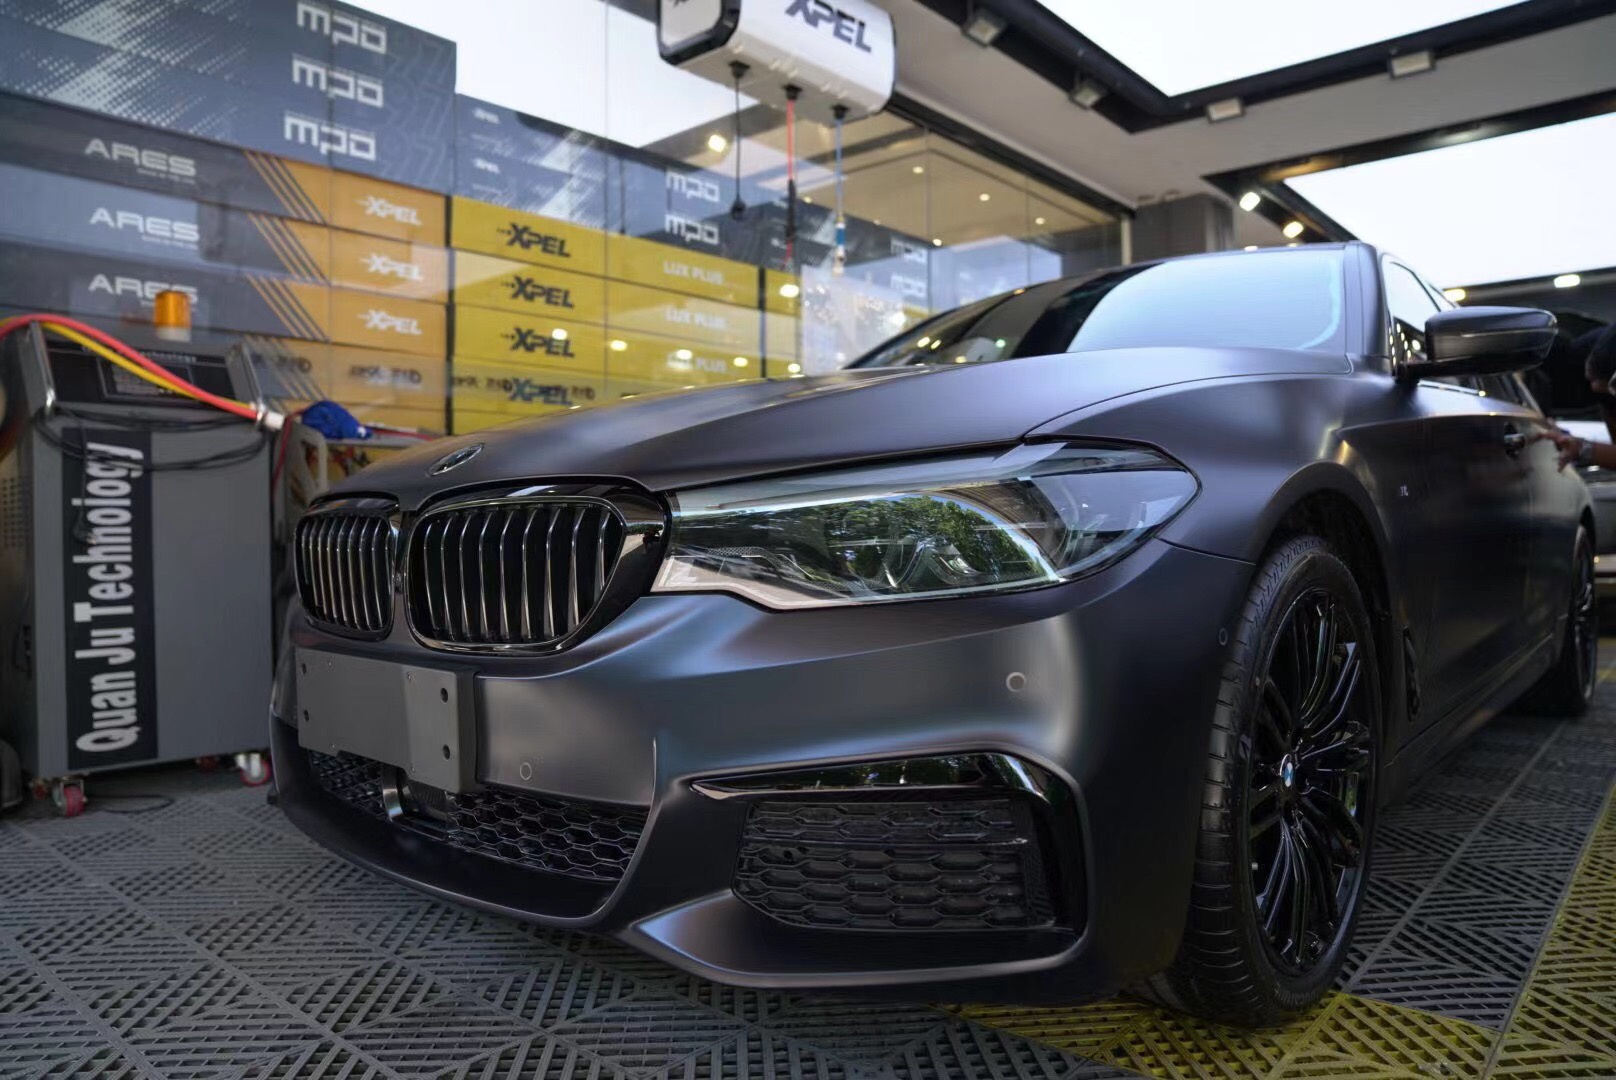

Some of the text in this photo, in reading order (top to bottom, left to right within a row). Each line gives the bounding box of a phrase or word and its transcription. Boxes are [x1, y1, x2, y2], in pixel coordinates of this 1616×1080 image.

[85, 138, 196, 177] ARES
[90, 207, 199, 242] ARES
[506, 221, 571, 259] XPEL
[510, 273, 575, 309] XPEL
[510, 326, 575, 358] XPEL
[71, 441, 145, 753] Quan Ju Technology
